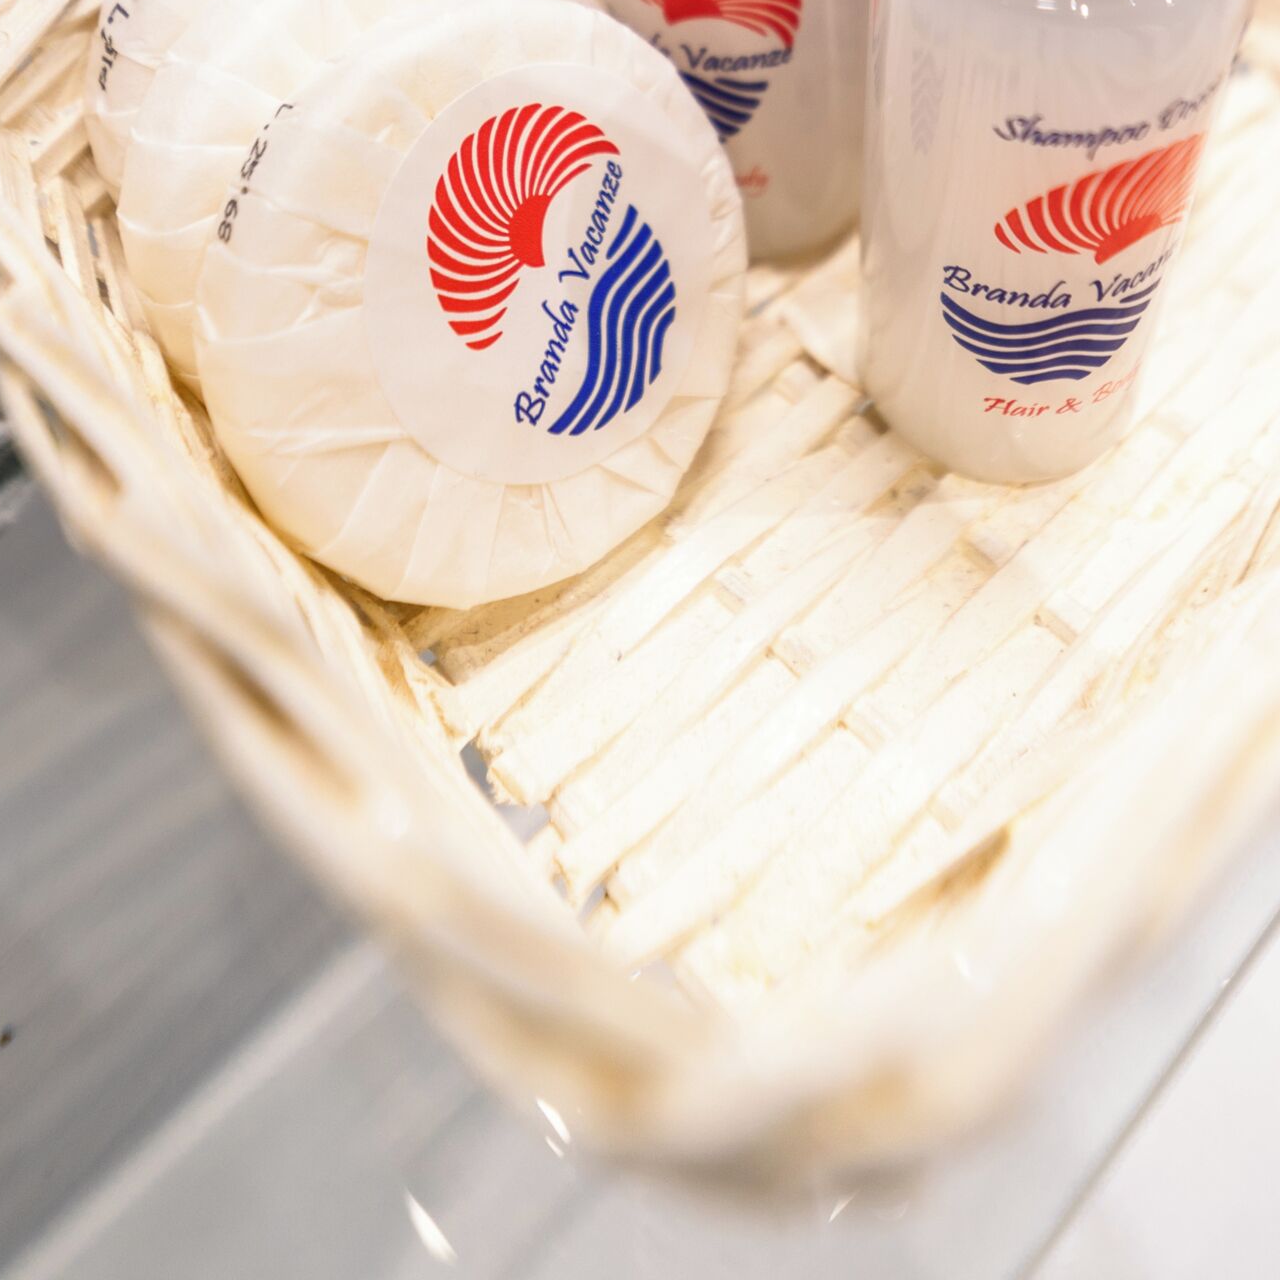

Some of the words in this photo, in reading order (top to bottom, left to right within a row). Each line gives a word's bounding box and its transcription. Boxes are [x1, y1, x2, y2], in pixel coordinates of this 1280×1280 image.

[679, 43, 793, 72] Vacanze
[993, 113, 1151, 161] Shampoo
[514, 299, 581, 427] Branda
[558, 159, 623, 284] Vacanze
[942, 264, 1072, 310] Branda
[1088, 238, 1180, 304] Vacan
[982, 396, 1051, 418] Hair
